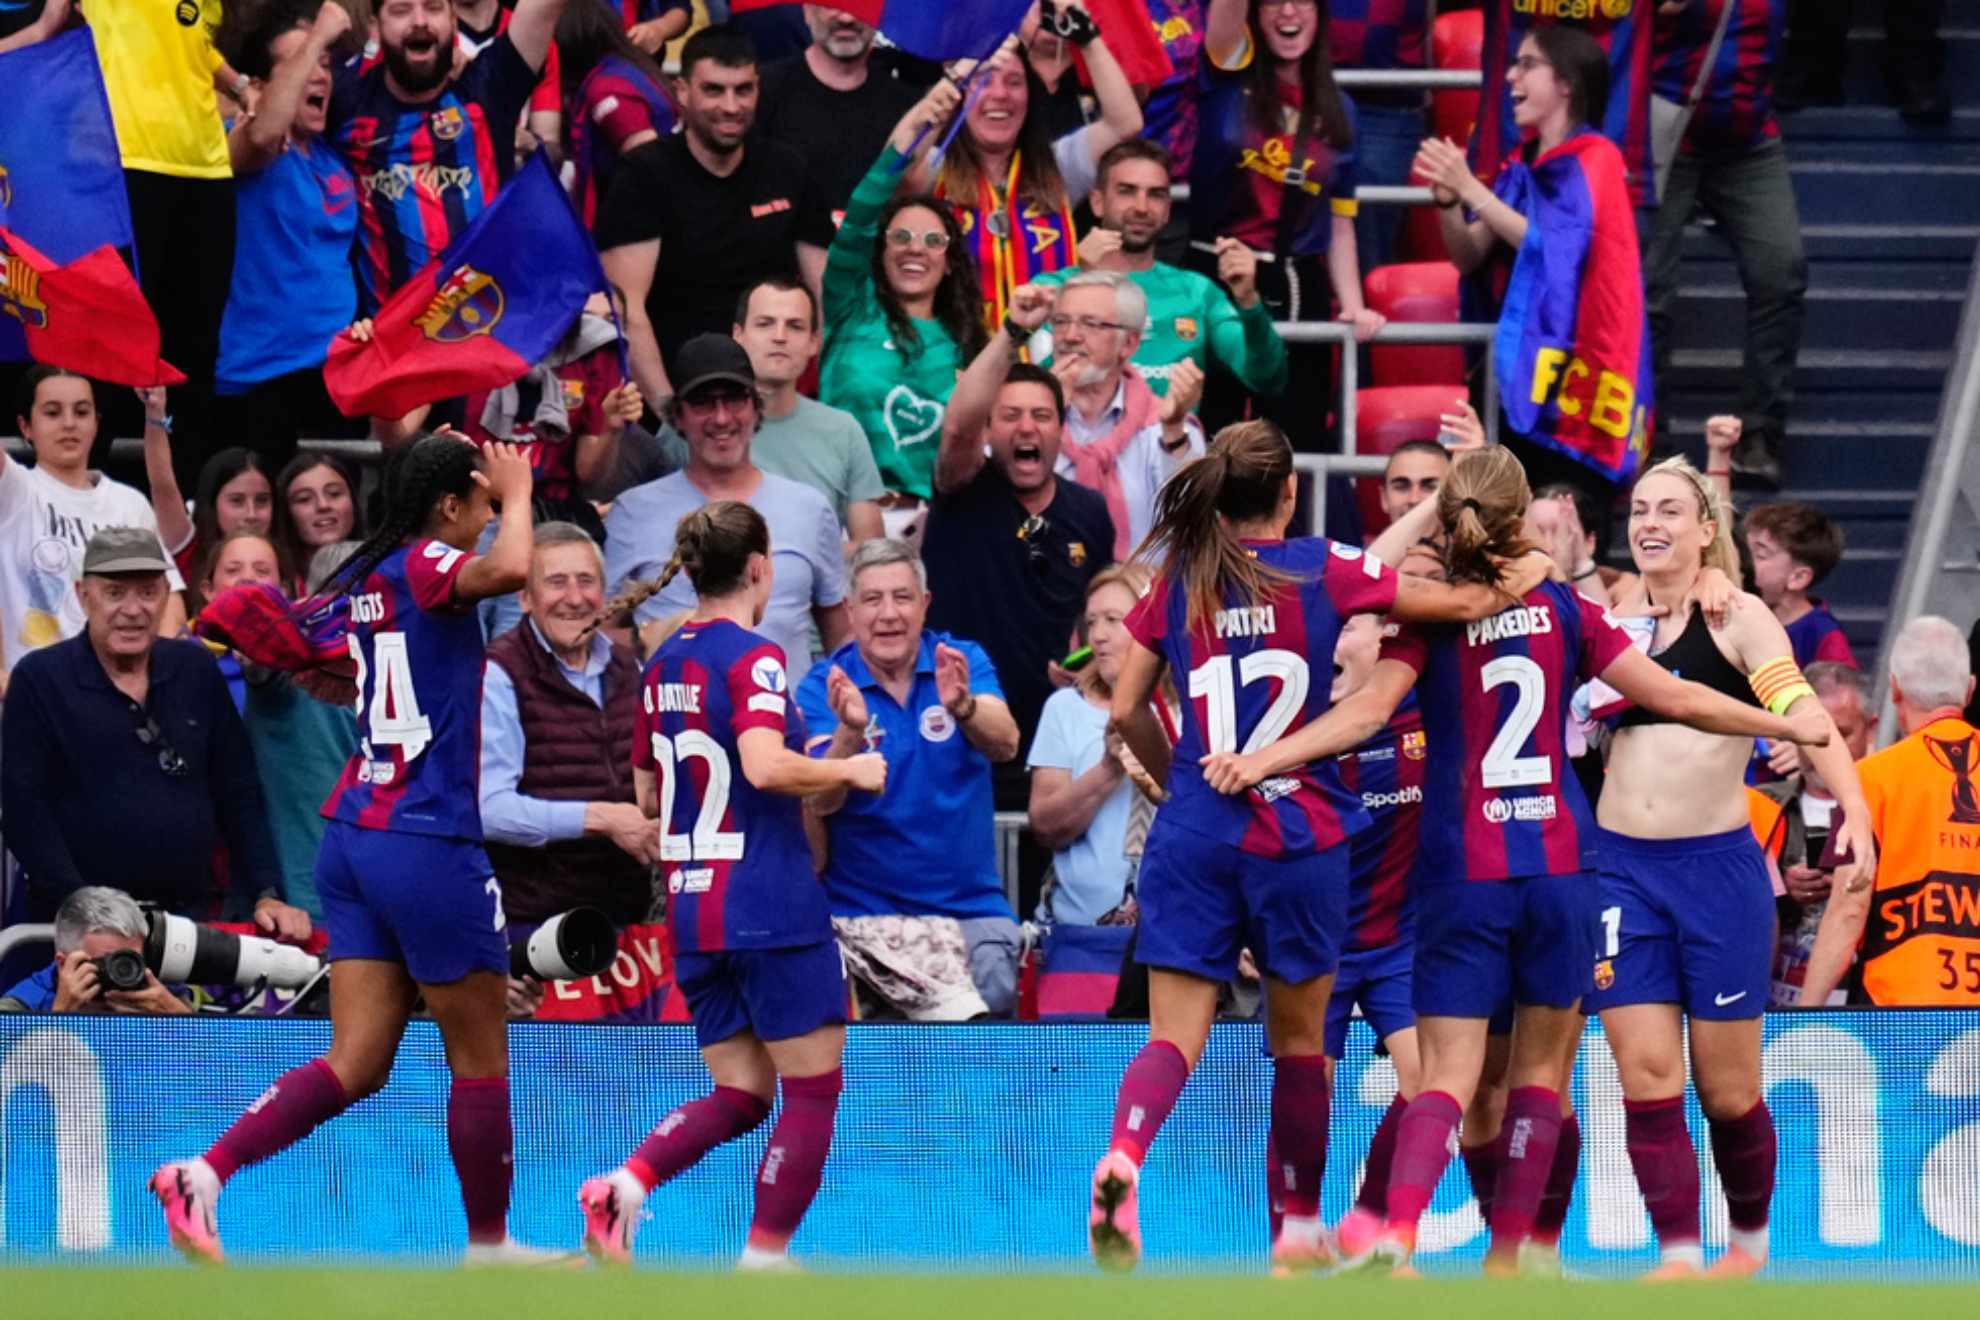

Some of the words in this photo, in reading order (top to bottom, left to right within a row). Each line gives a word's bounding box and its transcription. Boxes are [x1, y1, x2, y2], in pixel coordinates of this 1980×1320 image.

[1215, 604, 1276, 639] PATRI
[1466, 605, 1552, 647] PAREDES
[1188, 649, 1310, 757] 12
[1480, 655, 1552, 789] 2
[651, 729, 745, 862] 22
[1595, 906, 1622, 960] 1
[1880, 881, 1980, 941] STEW
[1937, 948, 1980, 994] 35
